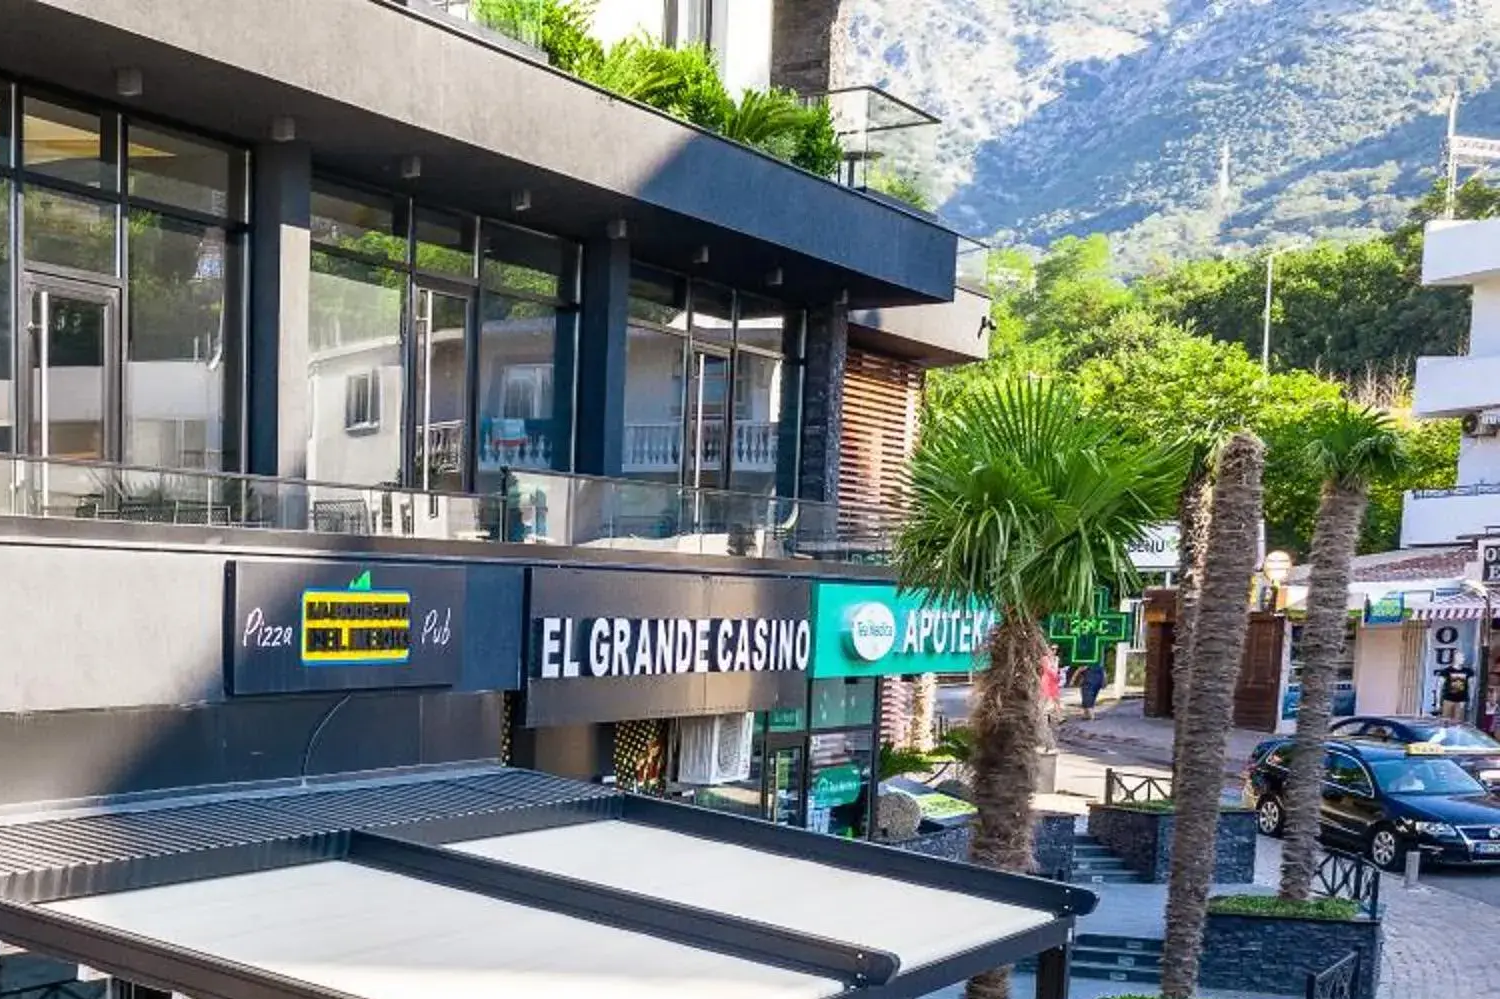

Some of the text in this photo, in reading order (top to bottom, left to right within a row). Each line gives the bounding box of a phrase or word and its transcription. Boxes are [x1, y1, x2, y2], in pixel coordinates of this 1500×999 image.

[243, 607, 293, 647] Pizza
[421, 607, 451, 646] Pub
[541, 617, 811, 678] EL GRANDE CASINO
